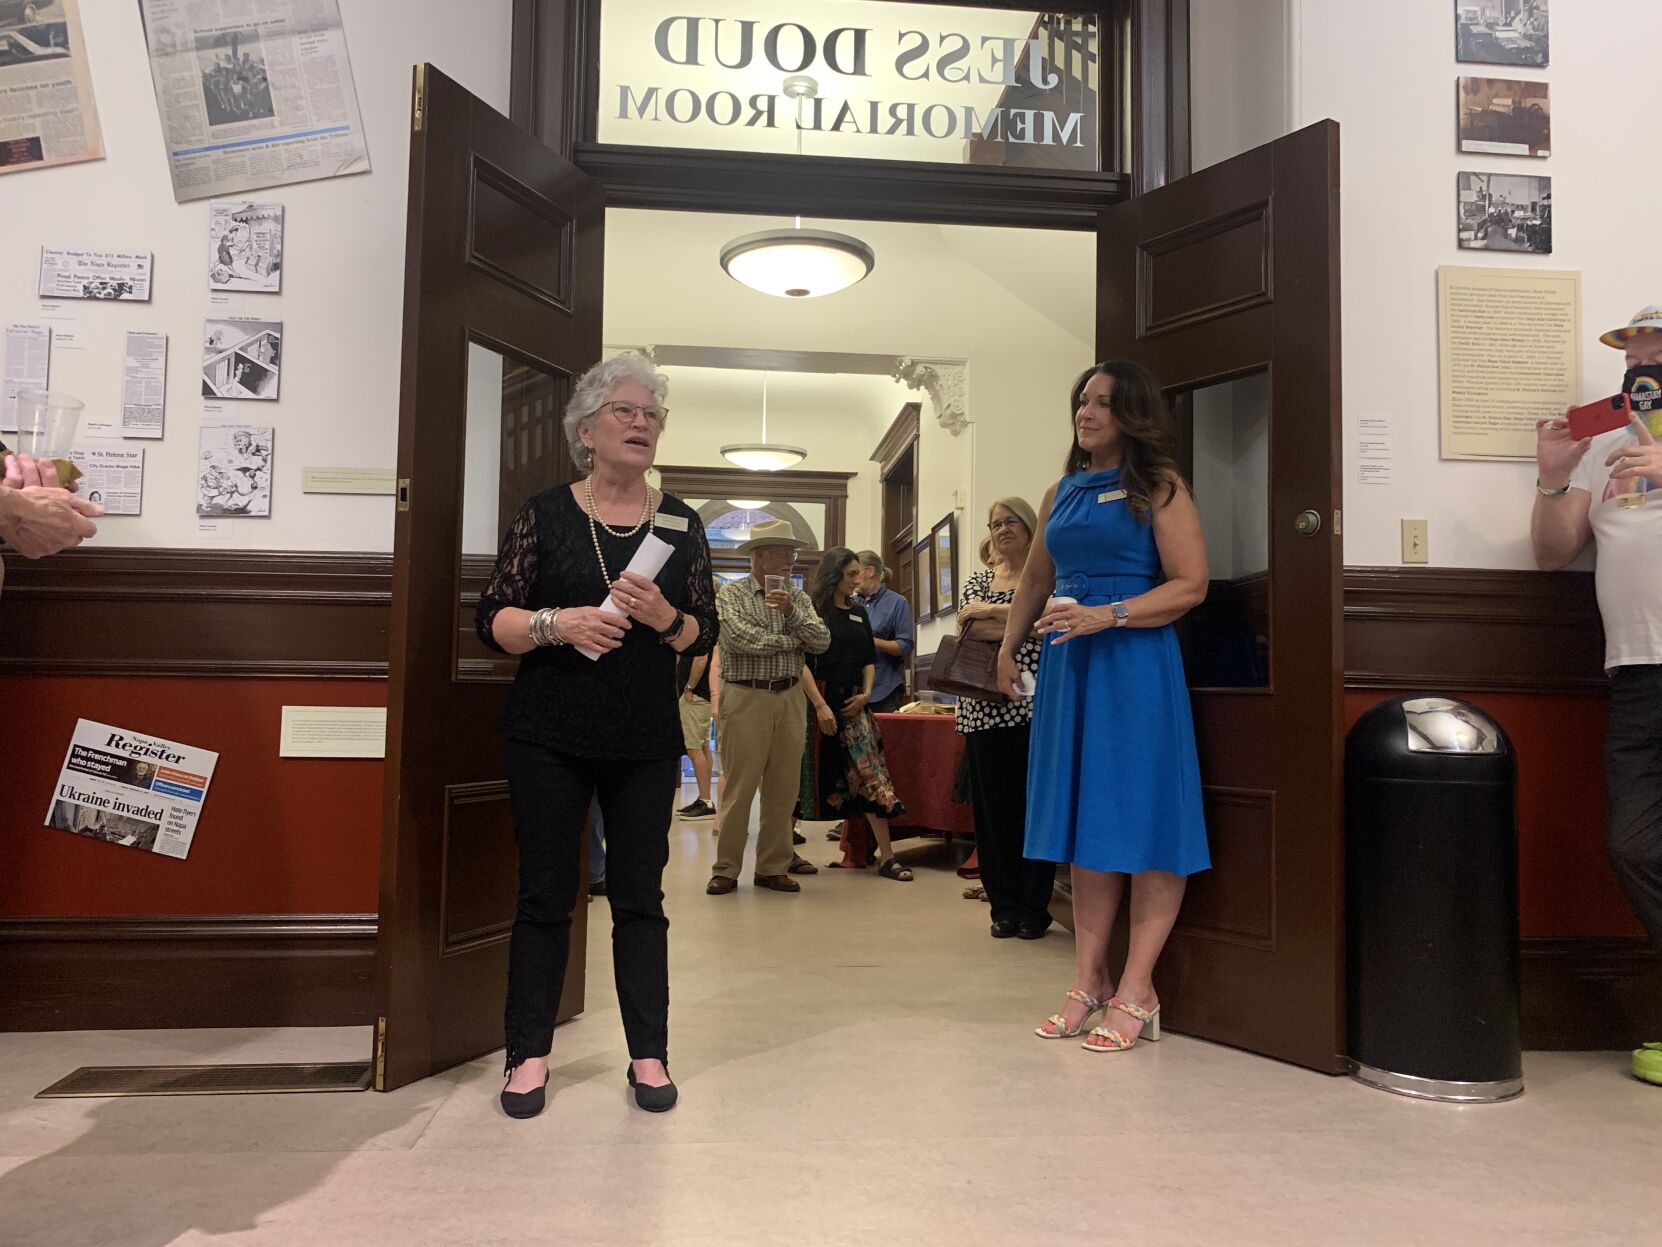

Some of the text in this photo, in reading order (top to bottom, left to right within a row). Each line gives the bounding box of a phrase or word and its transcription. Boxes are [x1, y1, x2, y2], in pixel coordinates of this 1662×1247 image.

[131, 735, 148, 746] Napa
[104, 732, 186, 765] Register
[71, 756, 87, 767] who
[86, 760, 112, 773] stayed
[74, 747, 128, 768] The Frenchman
[59, 783, 111, 809] Ukraine
[112, 796, 165, 822] invaded
[168, 812, 184, 822] found
[164, 826, 182, 836] streets
[174, 820, 187, 830] Napa
